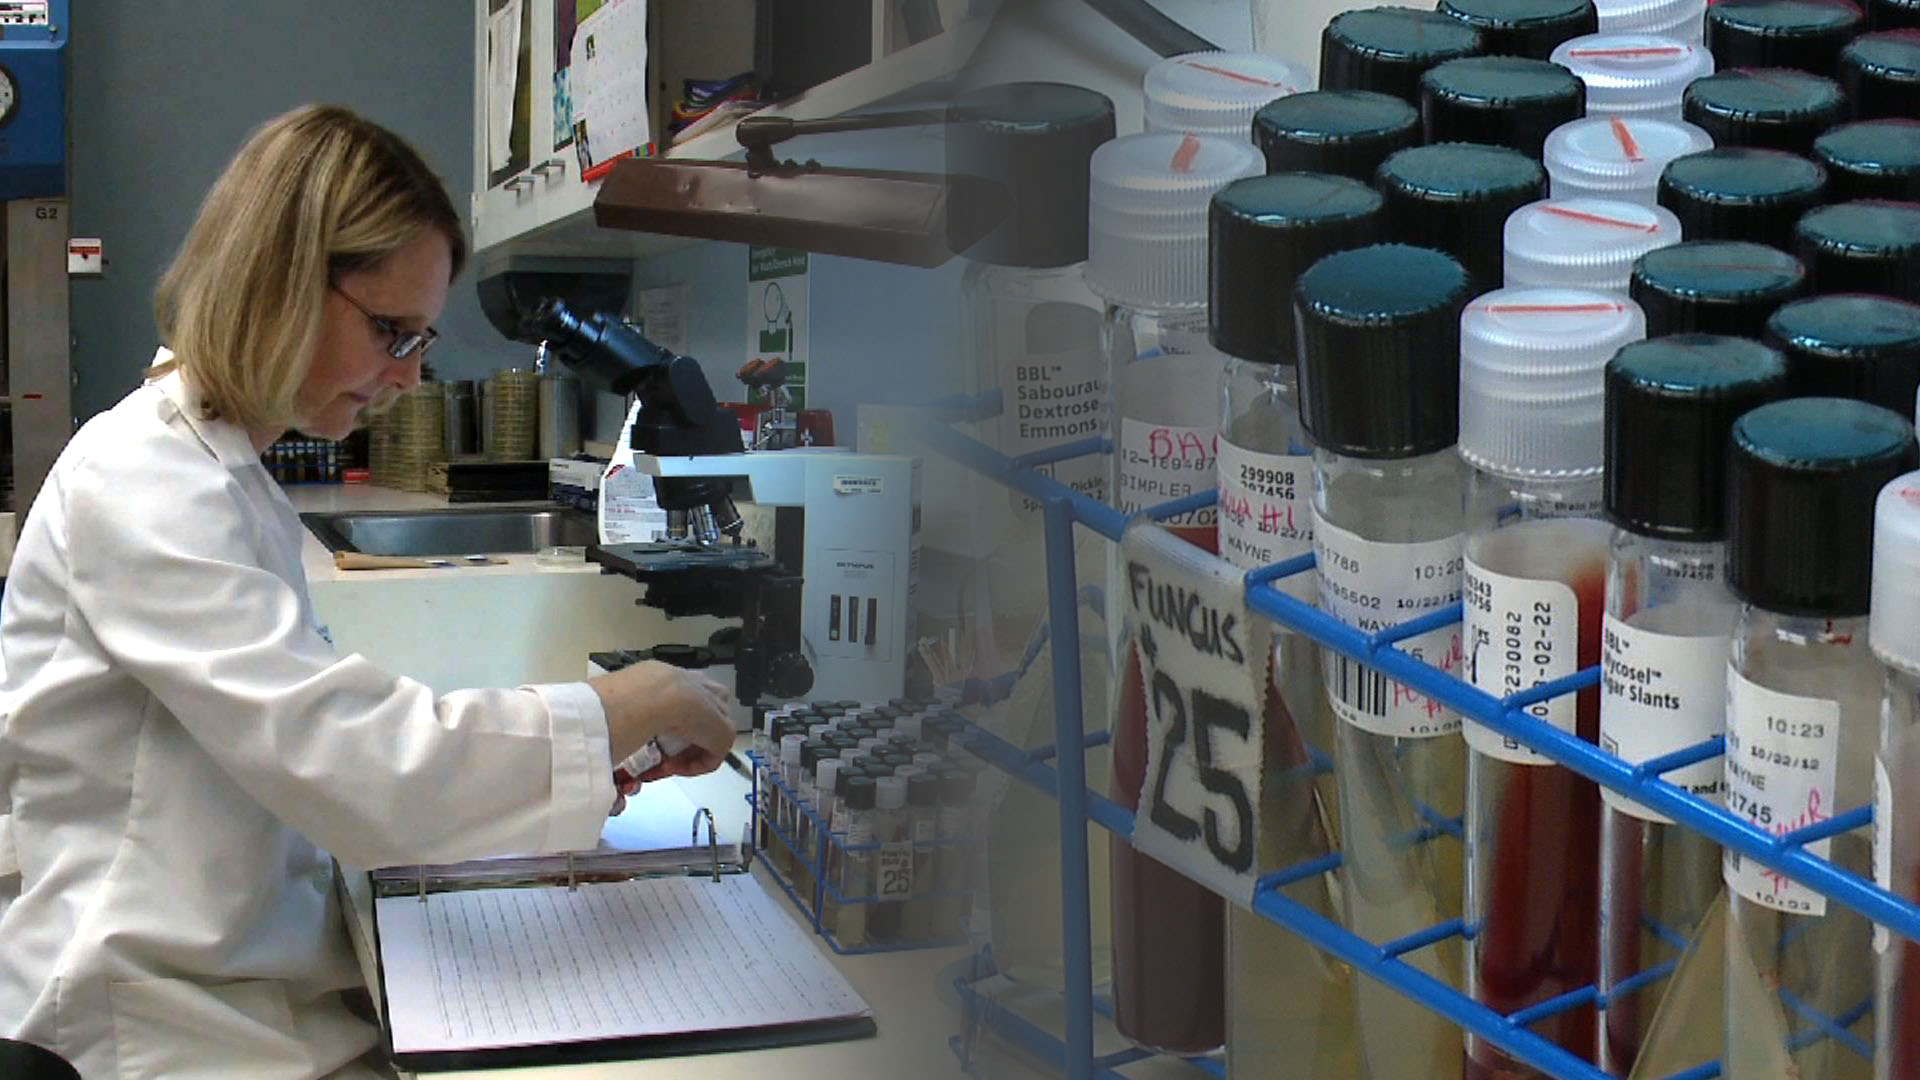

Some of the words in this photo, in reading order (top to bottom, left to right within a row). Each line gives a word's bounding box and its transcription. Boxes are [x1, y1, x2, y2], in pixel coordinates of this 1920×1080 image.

[36, 207, 58, 220] G2
[1018, 399, 1100, 420] Dextrose
[1020, 418, 1098, 438] Emmons
[1240, 464, 1295, 486] 299908
[1414, 557, 1464, 580] 10:20
[1629, 685, 1680, 711] Slants
[1766, 716, 1824, 739] 10:23
[1152, 668, 1254, 875] 25
[883, 870, 910, 895] 25
